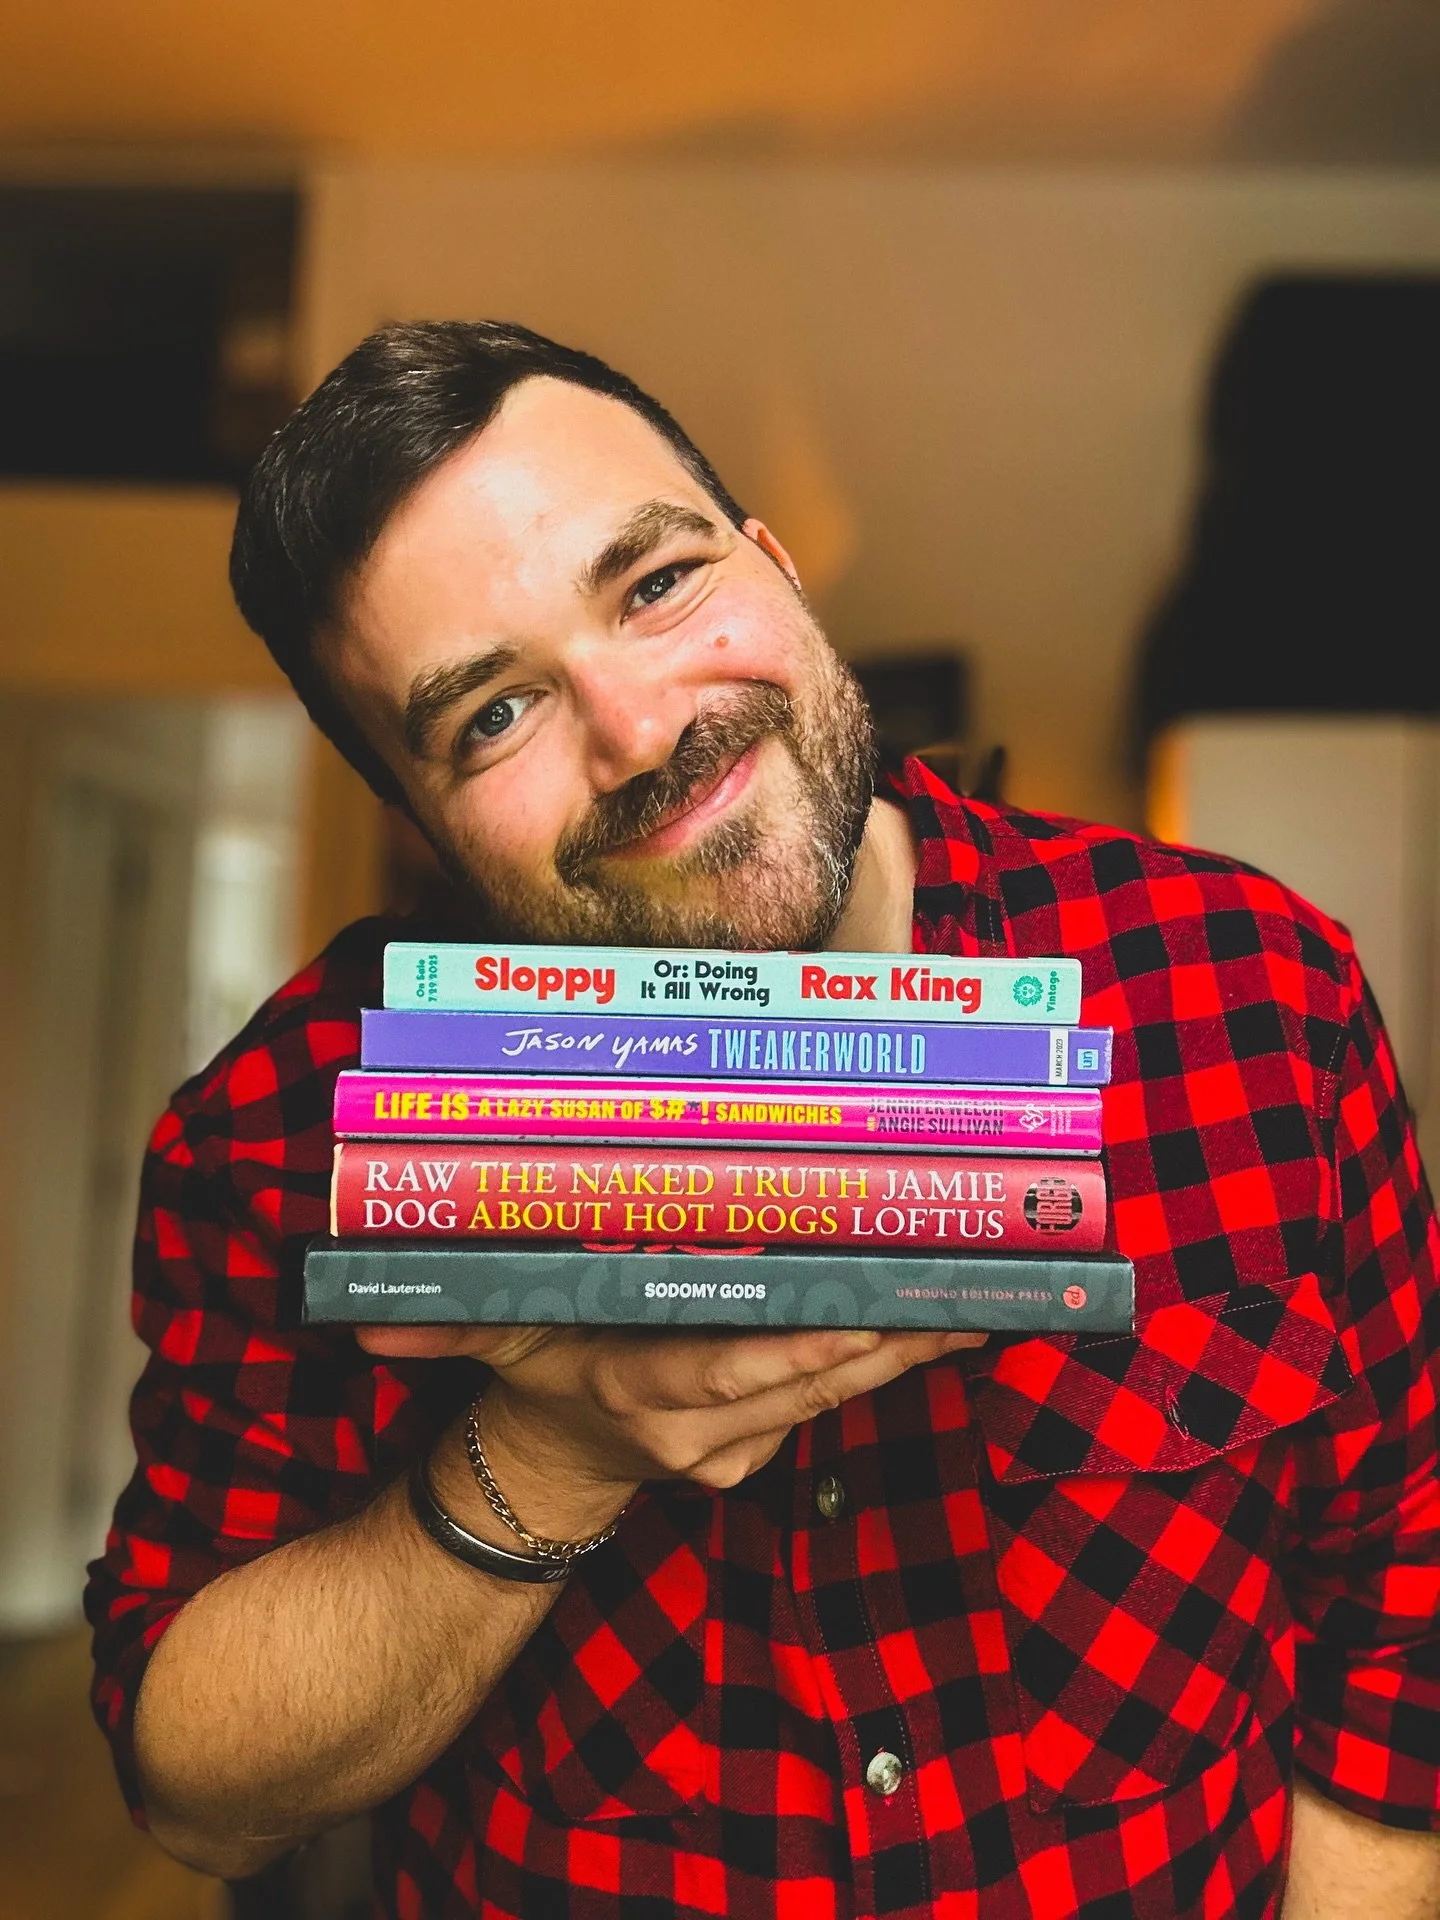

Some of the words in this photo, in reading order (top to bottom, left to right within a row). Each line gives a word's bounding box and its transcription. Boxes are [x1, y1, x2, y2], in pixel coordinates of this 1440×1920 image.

[416, 959, 425, 981] Sale
[475, 956, 615, 1004] Sloppy
[654, 960, 689, 978] Or:
[694, 961, 758, 985] Doing
[416, 983, 425, 997] On
[641, 981, 656, 999] It
[664, 981, 690, 999] All
[699, 982, 770, 1007] Wrong
[801, 965, 878, 1000] Rax
[890, 967, 982, 1014] King
[1047, 970, 1060, 1012] Vintage
[502, 1028, 604, 1056] JASON
[612, 1033, 698, 1069] YAMAS
[708, 1029, 926, 1074] TWEAKERWORLD
[1055, 1038, 1063, 1053] 2023
[1055, 1055, 1063, 1078] MARCH
[375, 1092, 432, 1119] LIFE
[441, 1093, 470, 1120] IS
[478, 1098, 491, 1117] A
[496, 1099, 544, 1118] LAZY
[550, 1100, 615, 1119] SUSAN
[620, 1101, 643, 1120] OF
[715, 1103, 842, 1125] SANDWICHES
[868, 1098, 945, 1114] JENNIFER
[949, 1100, 1004, 1117] WELCH
[876, 1117, 926, 1133] ANGIE
[927, 1118, 1004, 1135] SULLIVAN
[364, 1161, 460, 1192] RAW
[471, 1161, 557, 1193] THE
[568, 1162, 715, 1195] NAKED
[725, 1165, 869, 1199] TRUTH
[882, 1169, 1007, 1202] JAMIE
[363, 1199, 458, 1229] DOG
[468, 1200, 611, 1231] ABOUT
[623, 1202, 715, 1232] HOT
[725, 1204, 838, 1235] DOGS
[851, 1206, 1004, 1239] LOFTUS
[348, 1282, 380, 1293] David
[381, 1282, 442, 1294] Lauterstein
[644, 1282, 717, 1298] SODOMY
[720, 1283, 766, 1299] GODS
[895, 1287, 957, 1299] UNBOUND
[962, 1288, 1014, 1300] EDITION
[1018, 1290, 1053, 1300] PRESS
